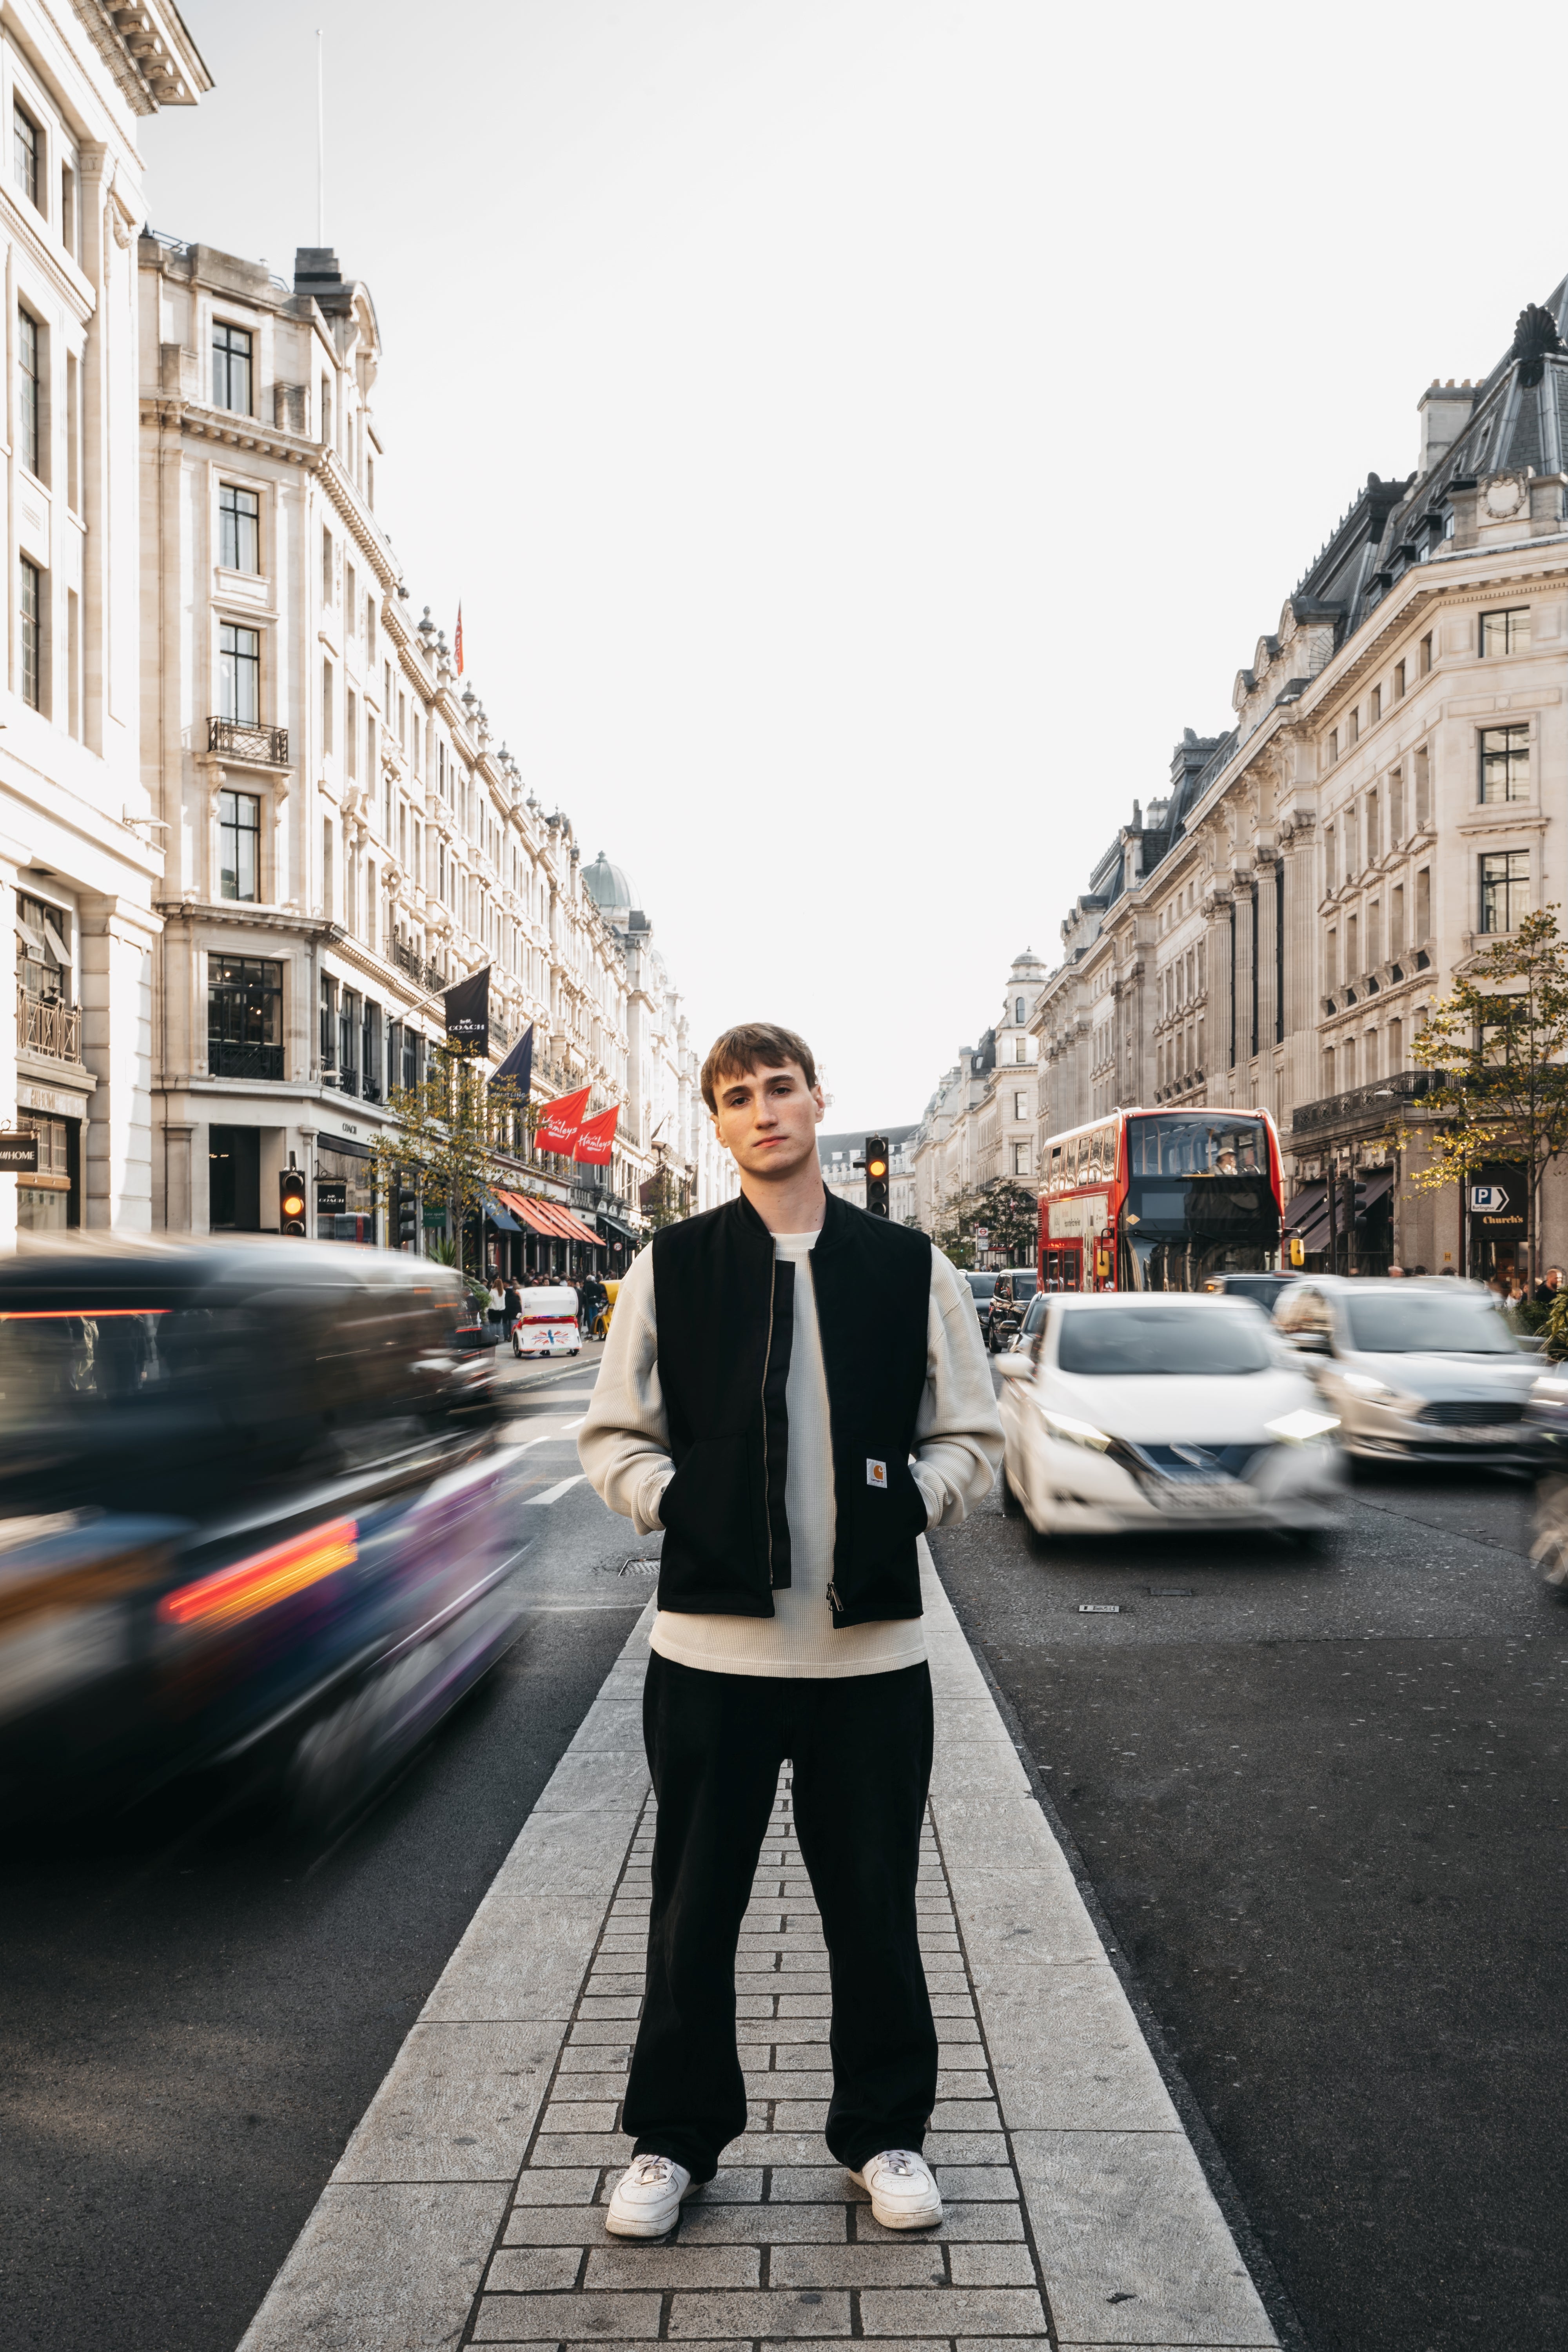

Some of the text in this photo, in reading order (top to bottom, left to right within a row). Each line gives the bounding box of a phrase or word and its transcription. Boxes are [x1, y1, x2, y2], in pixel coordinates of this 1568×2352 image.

[342, 1123, 357, 1135] COACH
[577, 1132, 612, 1152] Hamleys
[8, 1151, 35, 1160] HOME
[1478, 1189, 1488, 1203] P
[1483, 1216, 1523, 1224] Church's
